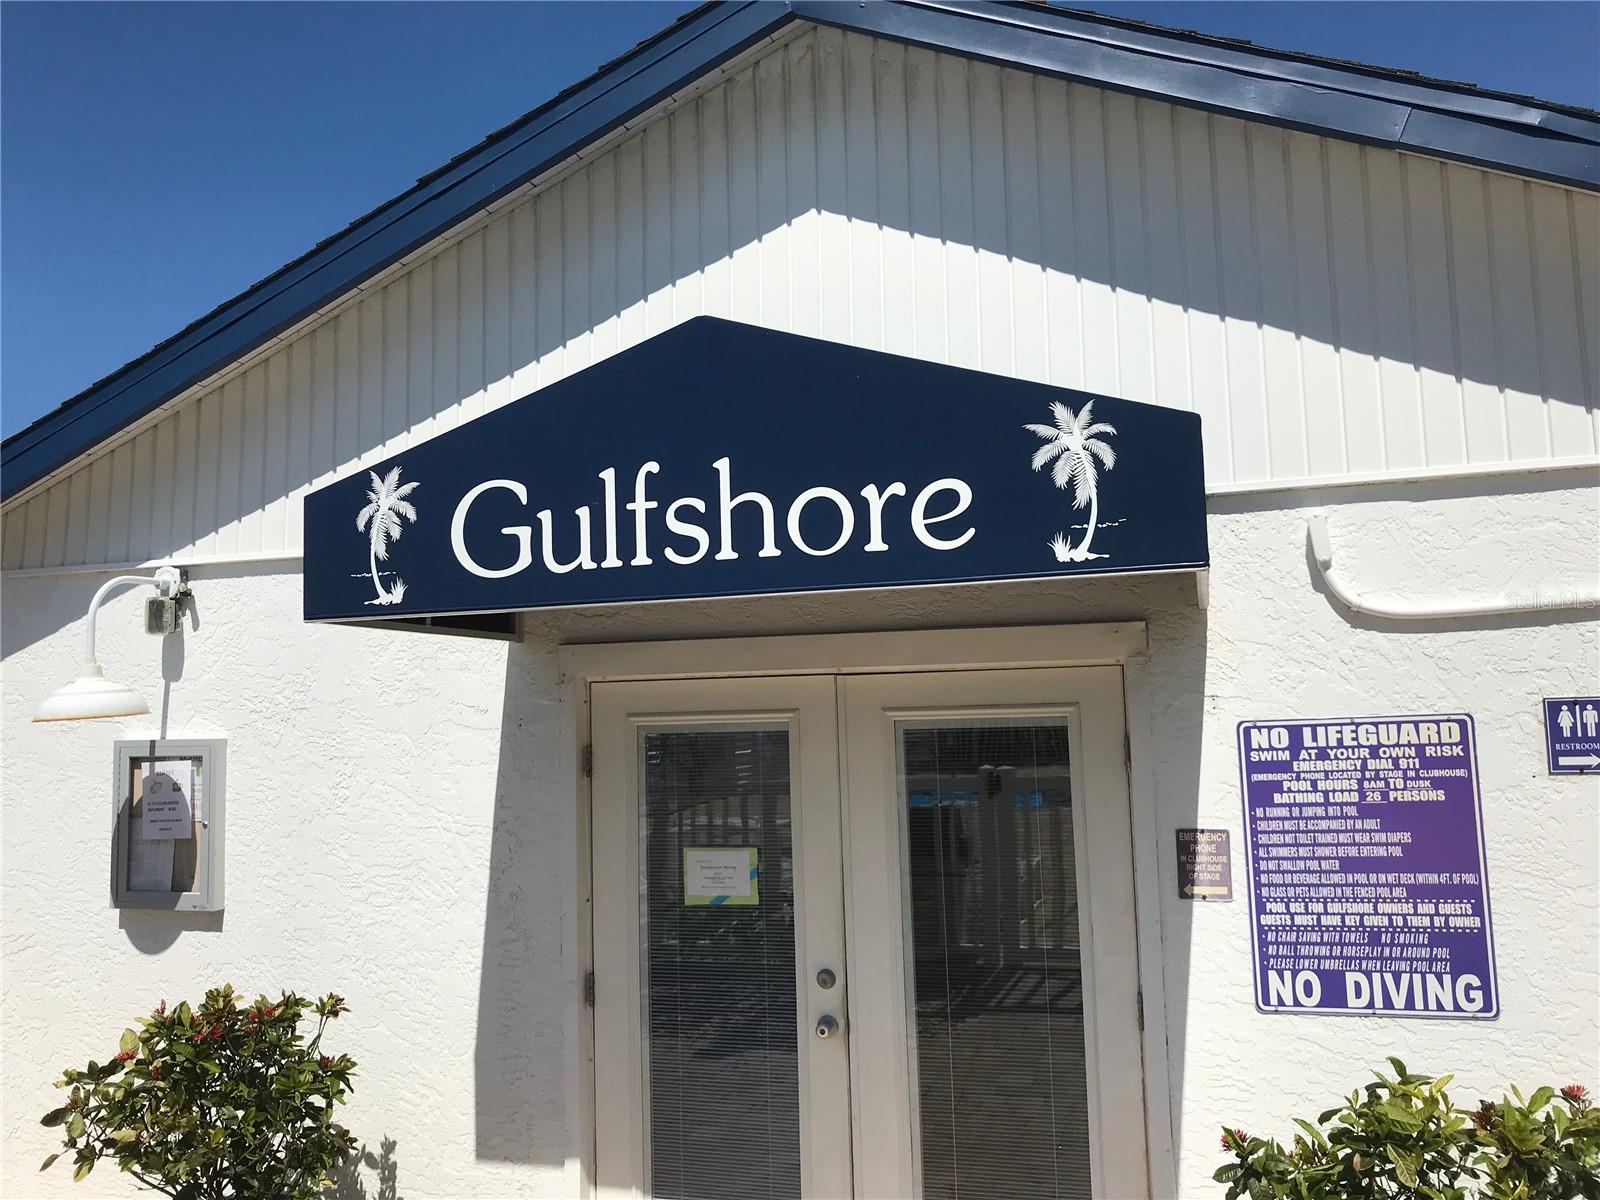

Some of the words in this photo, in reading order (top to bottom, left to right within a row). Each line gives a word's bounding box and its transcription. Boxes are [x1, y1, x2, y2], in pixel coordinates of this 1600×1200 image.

[450, 456, 977, 579] Gulfshore
[1250, 727, 1290, 749] NO
[1302, 722, 1461, 747] LIFEGUARD
[1250, 750, 1290, 762] SWIM
[1299, 749, 1318, 760] AT
[1326, 748, 1370, 759] YOUR
[1379, 746, 1416, 758] OWN
[1425, 745, 1465, 757] RISK
[1293, 759, 1362, 771] EMERGENCY
[1367, 758, 1395, 770] DIAL
[1398, 757, 1420, 769] 911
[1251, 773, 1297, 783] (EMERGENCY
[1300, 772, 1325, 780] PHONE
[1328, 771, 1362, 780] LOCATED
[1365, 771, 1376, 779] BY
[1379, 770, 1404, 779] STAGE
[1407, 770, 1416, 778] IN
[1419, 769, 1468, 779] CLUBHOUSE)
[1283, 780, 1313, 791] POOL
[1317, 779, 1359, 791] HOURS
[1363, 780, 1386, 789] 8AM
[1388, 778, 1405, 790] TO
[1406, 780, 1432, 789] DUSK
[1273, 792, 1324, 804] BATHING
[1328, 791, 1360, 803] LOAD
[1365, 791, 1382, 801] 26
[1388, 789, 1446, 802] PERSONS
[1256, 806, 1264, 817] NO
[1266, 806, 1290, 817] RUNNING
[1292, 806, 1300, 817] OR
[1302, 806, 1326, 817] JUMPING
[1327, 806, 1341, 817] INTO
[1342, 806, 1359, 816] POOL
[1257, 820, 1283, 830] CHILDREN
[1284, 820, 1298, 830] MUST
[1299, 820, 1307, 830] BE
[1308, 819, 1346, 830] ACCOMPANIED
[1346, 819, 1354, 830] BY
[1355, 819, 1363, 830] AN
[1364, 818, 1380, 830] ADULT
[1180, 832, 1228, 841] EMERGENCY
[1258, 834, 1284, 844] CHILDREN
[1284, 833, 1296, 844] NOT
[1296, 833, 1314, 844] TOILET
[1315, 833, 1338, 844] TRAINED
[1338, 832, 1354, 844] MUST
[1354, 832, 1370, 844] WEAR
[1371, 832, 1387, 844] SWIM
[1388, 832, 1412, 844] DIAPERS
[1190, 843, 1217, 852] PHONE
[1258, 846, 1268, 857] ALL
[1268, 846, 1298, 857] SWIMMERS
[1298, 846, 1314, 857] MUST
[1314, 846, 1337, 857] SHOWER
[1338, 846, 1360, 857] BEFORE
[1360, 846, 1388, 857] ENTERING
[1388, 846, 1404, 857] POOL
[1260, 860, 1268, 870] DO
[1268, 860, 1278, 870] NOT
[1279, 860, 1305, 870] SWALLOW
[1306, 860, 1320, 870] POOL
[1321, 860, 1340, 870] WATER
[1260, 874, 1268, 884] NO
[1269, 874, 1284, 884] FOOD
[1284, 874, 1292, 884] OR
[1292, 874, 1320, 884] BEVERAGE
[1321, 873, 1346, 884] ALLOWED
[1346, 873, 1353, 884] IN
[1354, 873, 1368, 884] POOL
[1369, 873, 1378, 884] OR
[1378, 873, 1386, 884] ON
[1387, 873, 1399, 884] WET
[1400, 873, 1416, 884] DECK
[1416, 873, 1438, 886] (WITHIN
[1440, 873, 1452, 884] 4FT.
[1452, 873, 1461, 884] OF
[1461, 873, 1479, 886] POOL)
[1262, 886, 1270, 898] NO
[1270, 886, 1286, 898] GLASS
[1286, 886, 1295, 898] OR
[1296, 886, 1310, 898] PETS
[1310, 886, 1335, 898] ALLOWED
[1336, 886, 1342, 898] IN
[1342, 886, 1354, 898] THE
[1354, 886, 1376, 898] FENCED
[1376, 886, 1392, 898] POOL
[1392, 886, 1408, 898] AREA
[1266, 902, 1287, 913] POOL
[1289, 902, 1306, 914] USE
[1308, 902, 1324, 914] FOR
[1326, 902, 1374, 914] GULFSHORE
[1377, 902, 1414, 914] OWNERS
[1417, 903, 1436, 914] AND
[1438, 903, 1472, 914] GUESTS
[1260, 914, 1292, 926] GUESTS
[1294, 914, 1318, 926] MUST
[1320, 915, 1342, 926] HAVE
[1344, 915, 1360, 926] KEY
[1364, 915, 1389, 926] GIVEN
[1392, 916, 1404, 927] TO
[1406, 916, 1430, 927] THEM
[1433, 916, 1446, 927] BY
[1448, 916, 1481, 928] OWNER
[1266, 932, 1276, 942] NO
[1278, 932, 1297, 942] CHAIR
[1298, 932, 1321, 942] SAVING
[1323, 932, 1340, 942] WITH
[1342, 932, 1369, 944] TOWELS
[1380, 932, 1392, 944] NO
[1394, 932, 1429, 944] SMOKING
[1268, 944, 1278, 956] NO
[1278, 944, 1294, 956] BALL
[1296, 945, 1330, 956] THROWING
[1332, 946, 1342, 956] OR
[1342, 946, 1382, 958] HORSEPLAY
[1383, 946, 1390, 958] IN
[1392, 946, 1402, 958] OR
[1402, 946, 1430, 958] AROUND
[1432, 947, 1450, 958] POOL
[1268, 958, 1294, 969] PLEASE
[1295, 958, 1318, 970] LOWER
[1320, 959, 1360, 970] UMBRELLAS
[1361, 960, 1380, 971] WHEN
[1382, 960, 1410, 972] LEAVING
[1412, 960, 1430, 972] POOL
[1431, 961, 1450, 972] AREA
[1267, 970, 1322, 1007] NO
[1345, 972, 1484, 1012] DIVING
